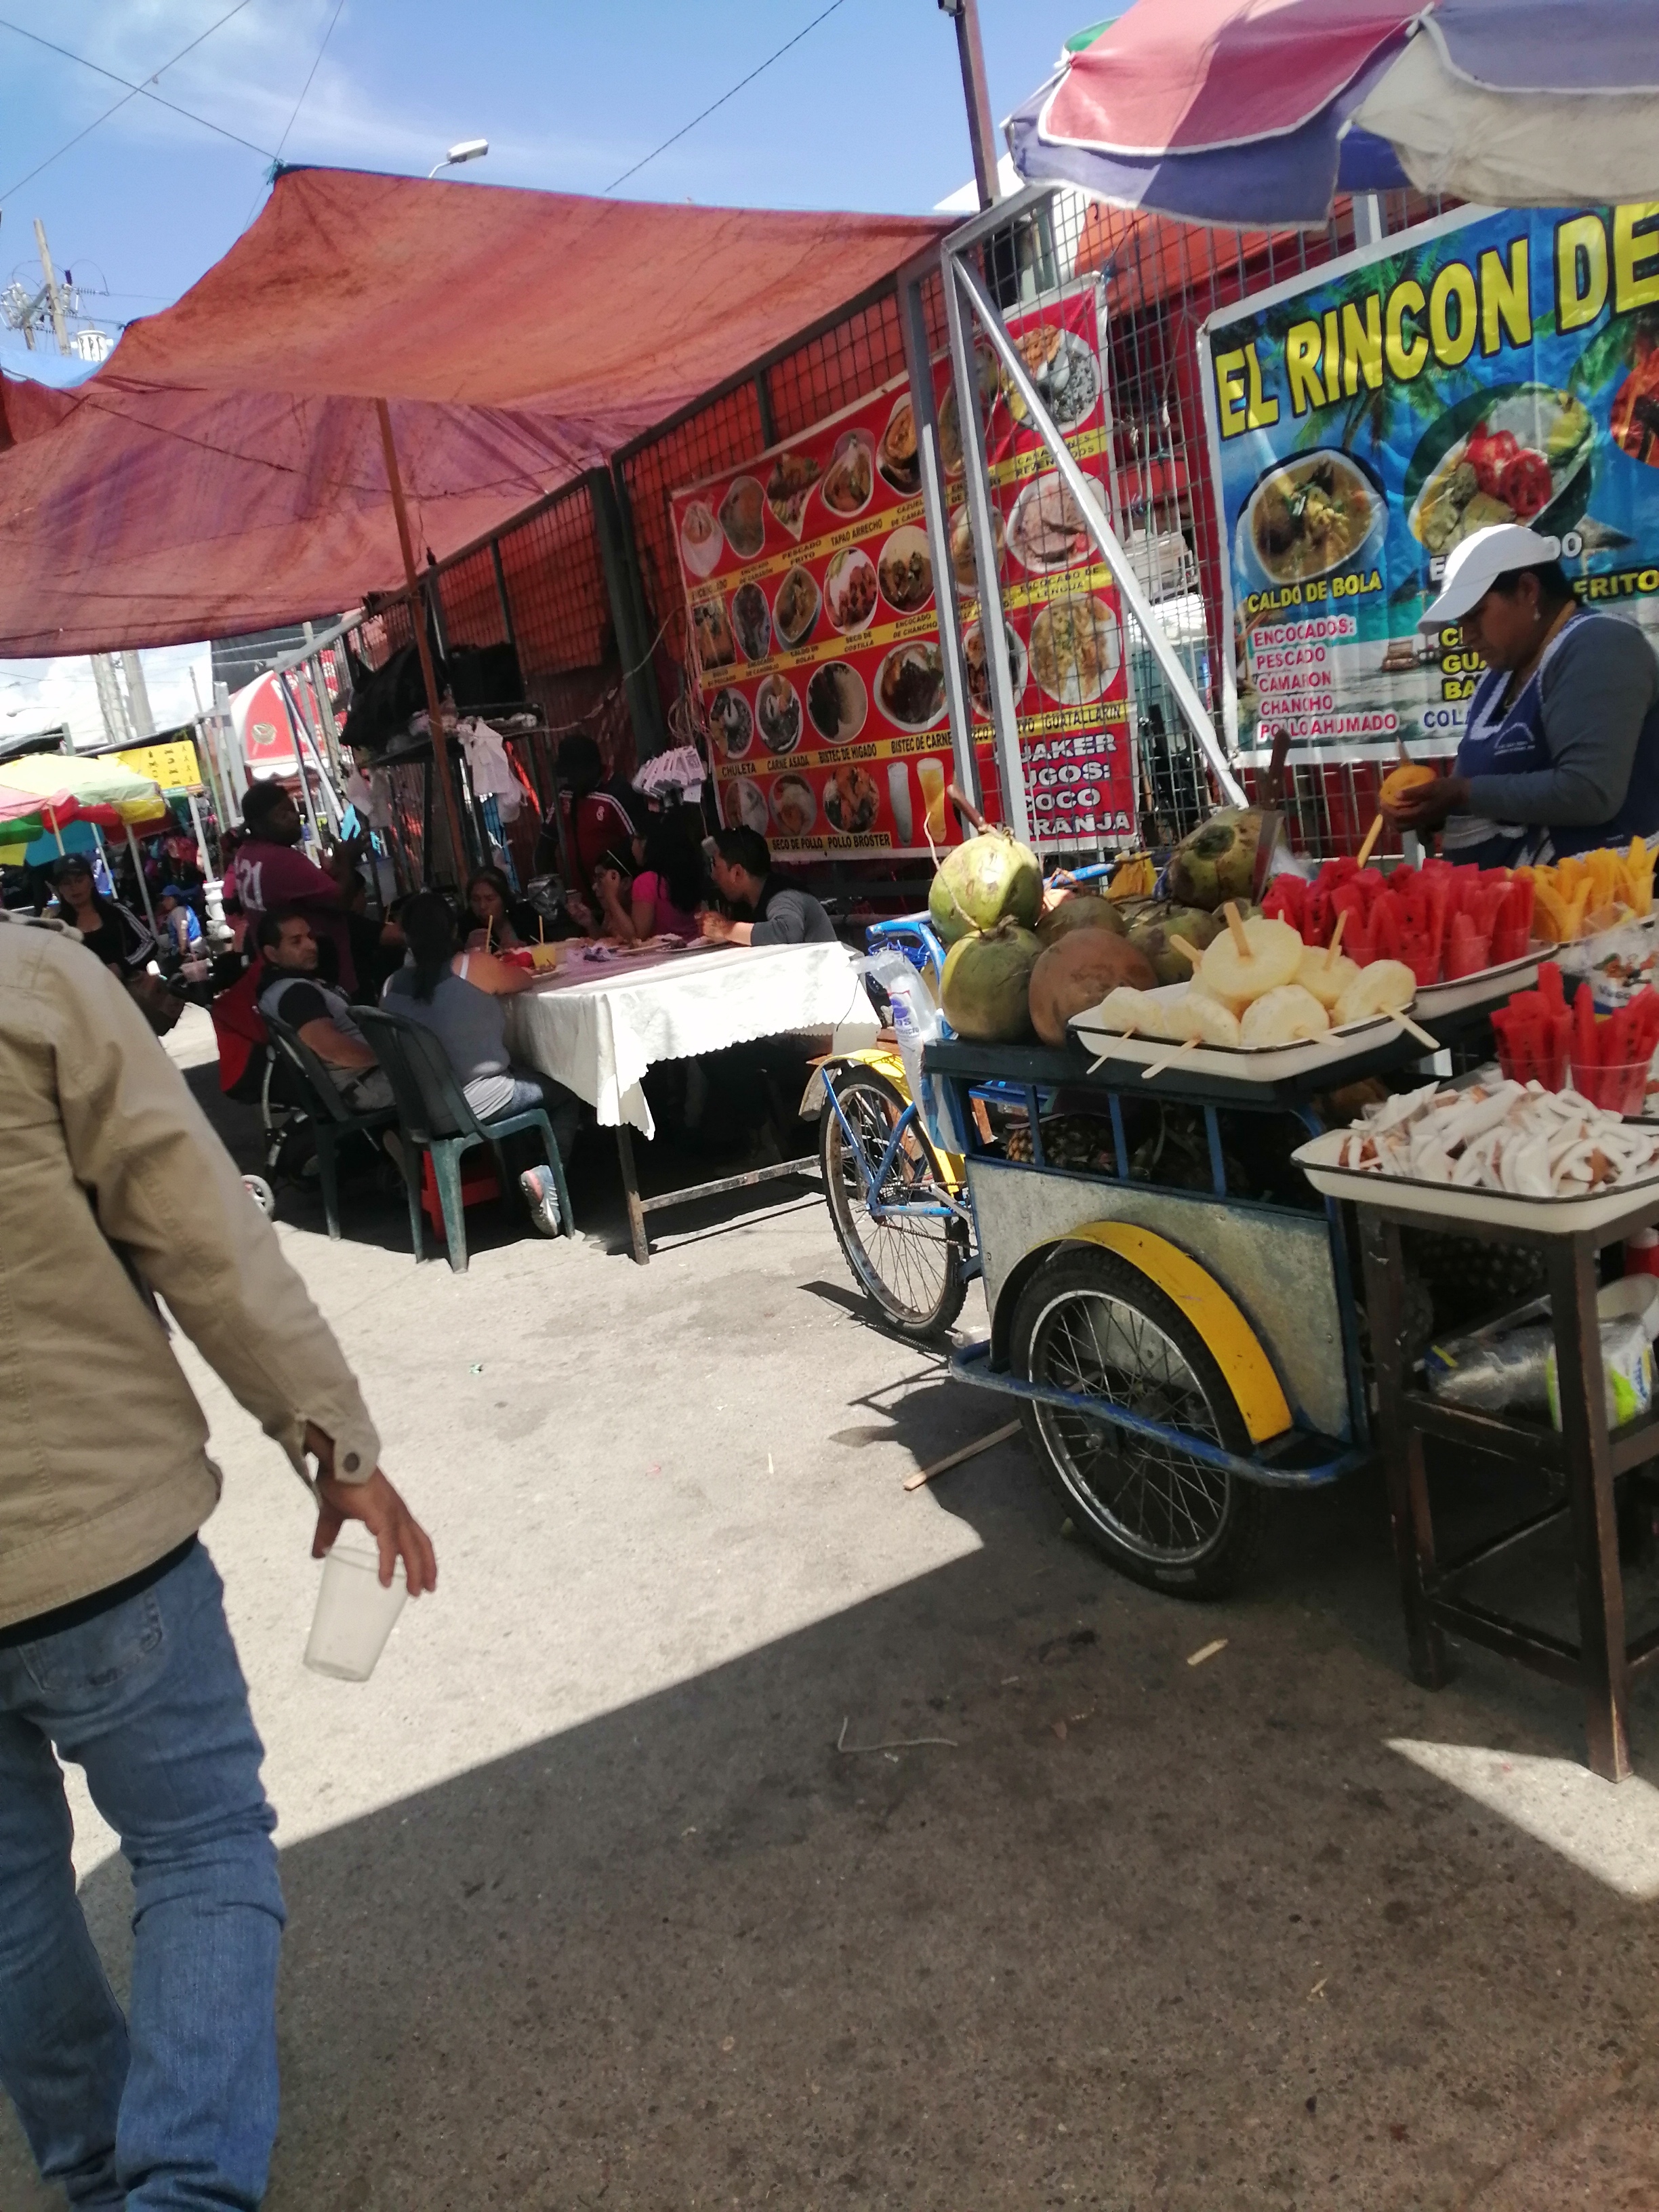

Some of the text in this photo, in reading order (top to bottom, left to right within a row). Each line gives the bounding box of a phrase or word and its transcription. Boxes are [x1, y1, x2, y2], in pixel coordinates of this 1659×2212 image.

[1214, 343, 1279, 440] EL
[1285, 238, 1533, 416] RINCON
[852, 518, 882, 538] ARRECHO
[782, 539, 822, 560] PESCADO
[790, 552, 815, 565] FRITO
[1020, 571, 1080, 593] ENCOCADO
[1037, 581, 1084, 598] LENGUA
[1247, 571, 1382, 613] CALDO DE BOLA
[893, 621, 938, 639] DE CHANCHO
[895, 613, 931, 629] ENCOCADO
[846, 631, 872, 644] SECO DE
[1254, 617, 1355, 647] ENCOCADOS:
[844, 640, 874, 653] COSTILLA
[1256, 647, 1326, 670] PESCADO
[1258, 671, 1332, 693] CAMARON
[1261, 695, 1332, 716] CHANCHO
[1260, 713, 1397, 739] POLO AHUMADO
[890, 731, 953, 754] BISTEC DE CARNE
[818, 742, 877, 764] BISTEC DE HIGADO
[722, 762, 757, 777] CHULETA
[767, 756, 810, 771] CARNE ASADA
[772, 837, 823, 851] SECO DE POLLO
[827, 834, 891, 848] POLLO BROSTER
